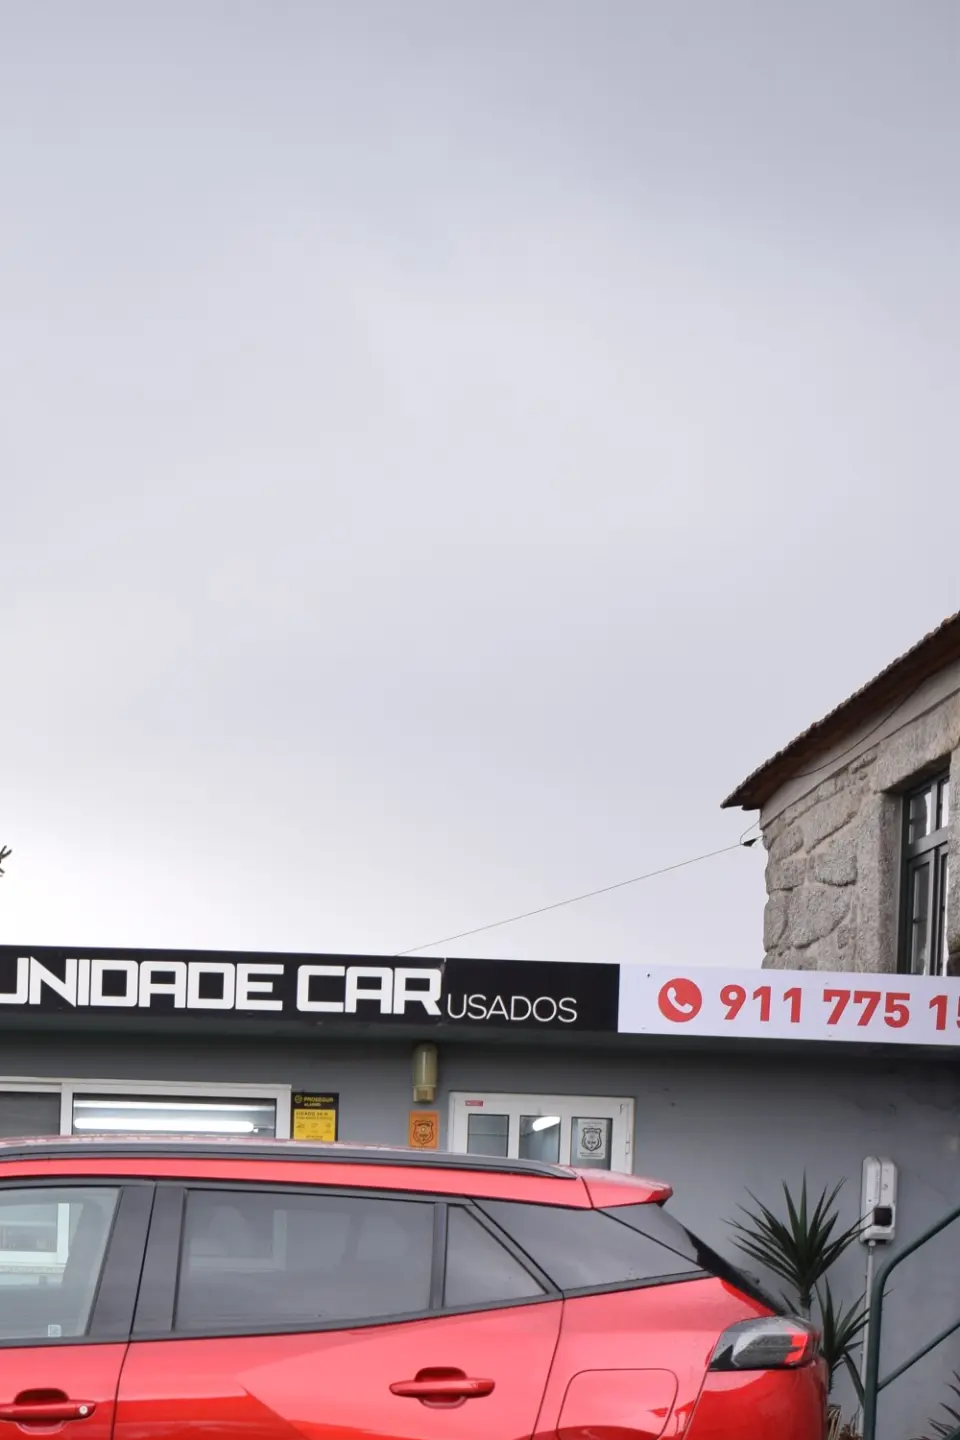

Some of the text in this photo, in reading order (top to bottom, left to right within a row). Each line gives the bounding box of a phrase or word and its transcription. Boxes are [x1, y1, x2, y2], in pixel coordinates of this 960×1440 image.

[296, 964, 443, 1016] CAR
[446, 993, 578, 1023] USADOS
[720, 984, 960, 1030] 911 775 1
